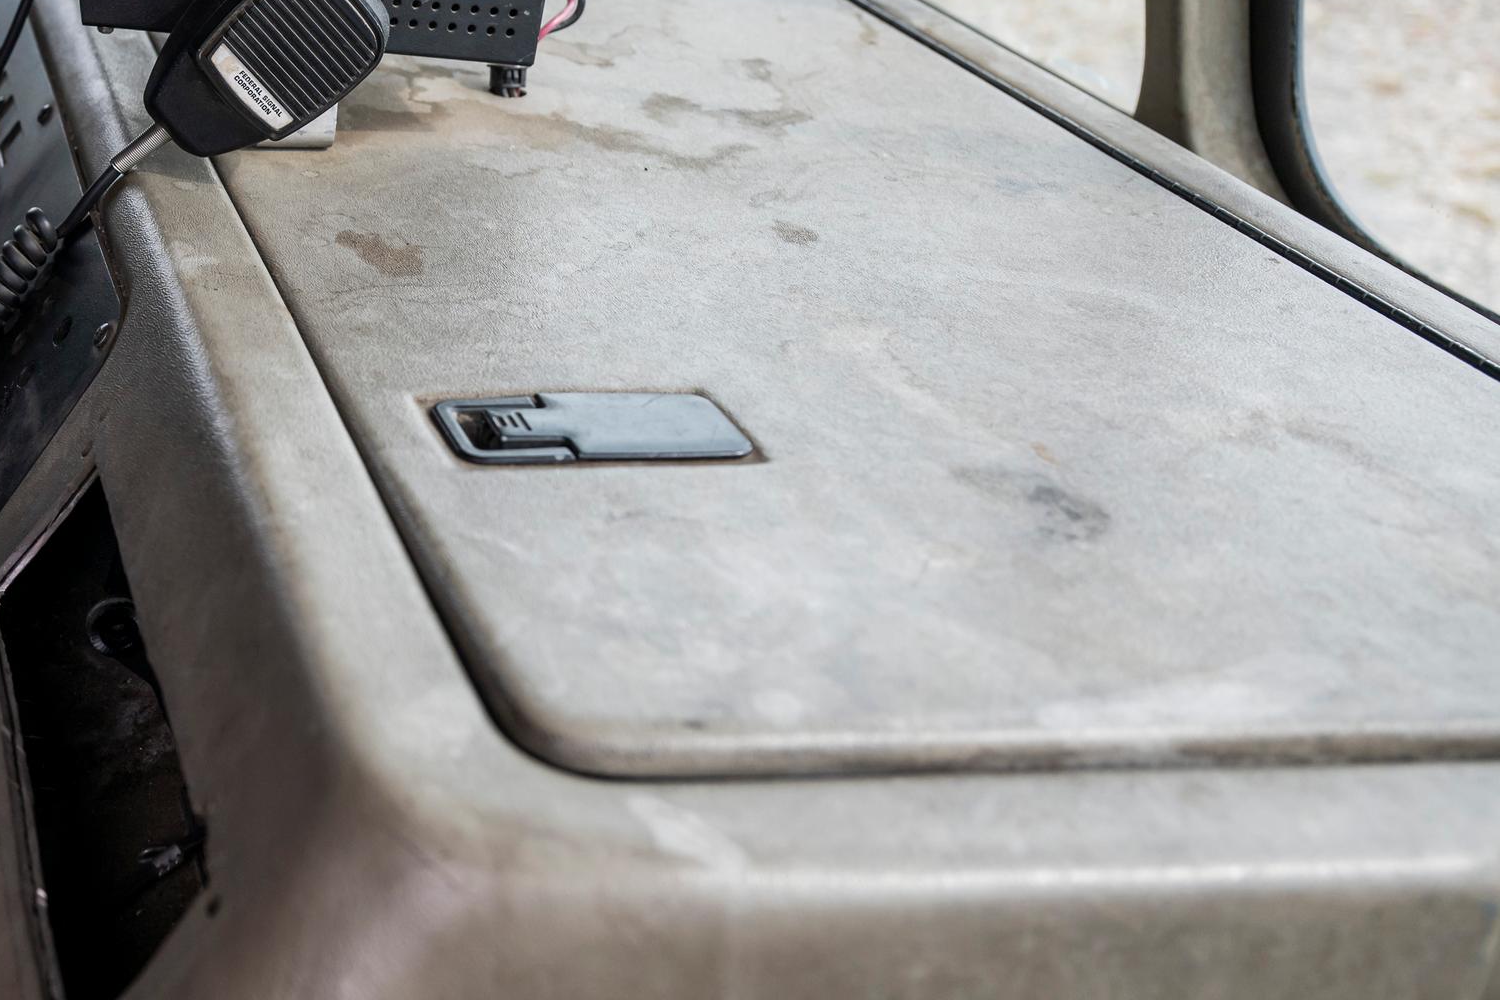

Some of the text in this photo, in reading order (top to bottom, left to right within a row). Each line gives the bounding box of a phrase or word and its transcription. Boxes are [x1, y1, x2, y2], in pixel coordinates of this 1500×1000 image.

[233, 75, 272, 115] CORPORATION
[238, 70, 283, 118] FEDERAL SIGNAL
